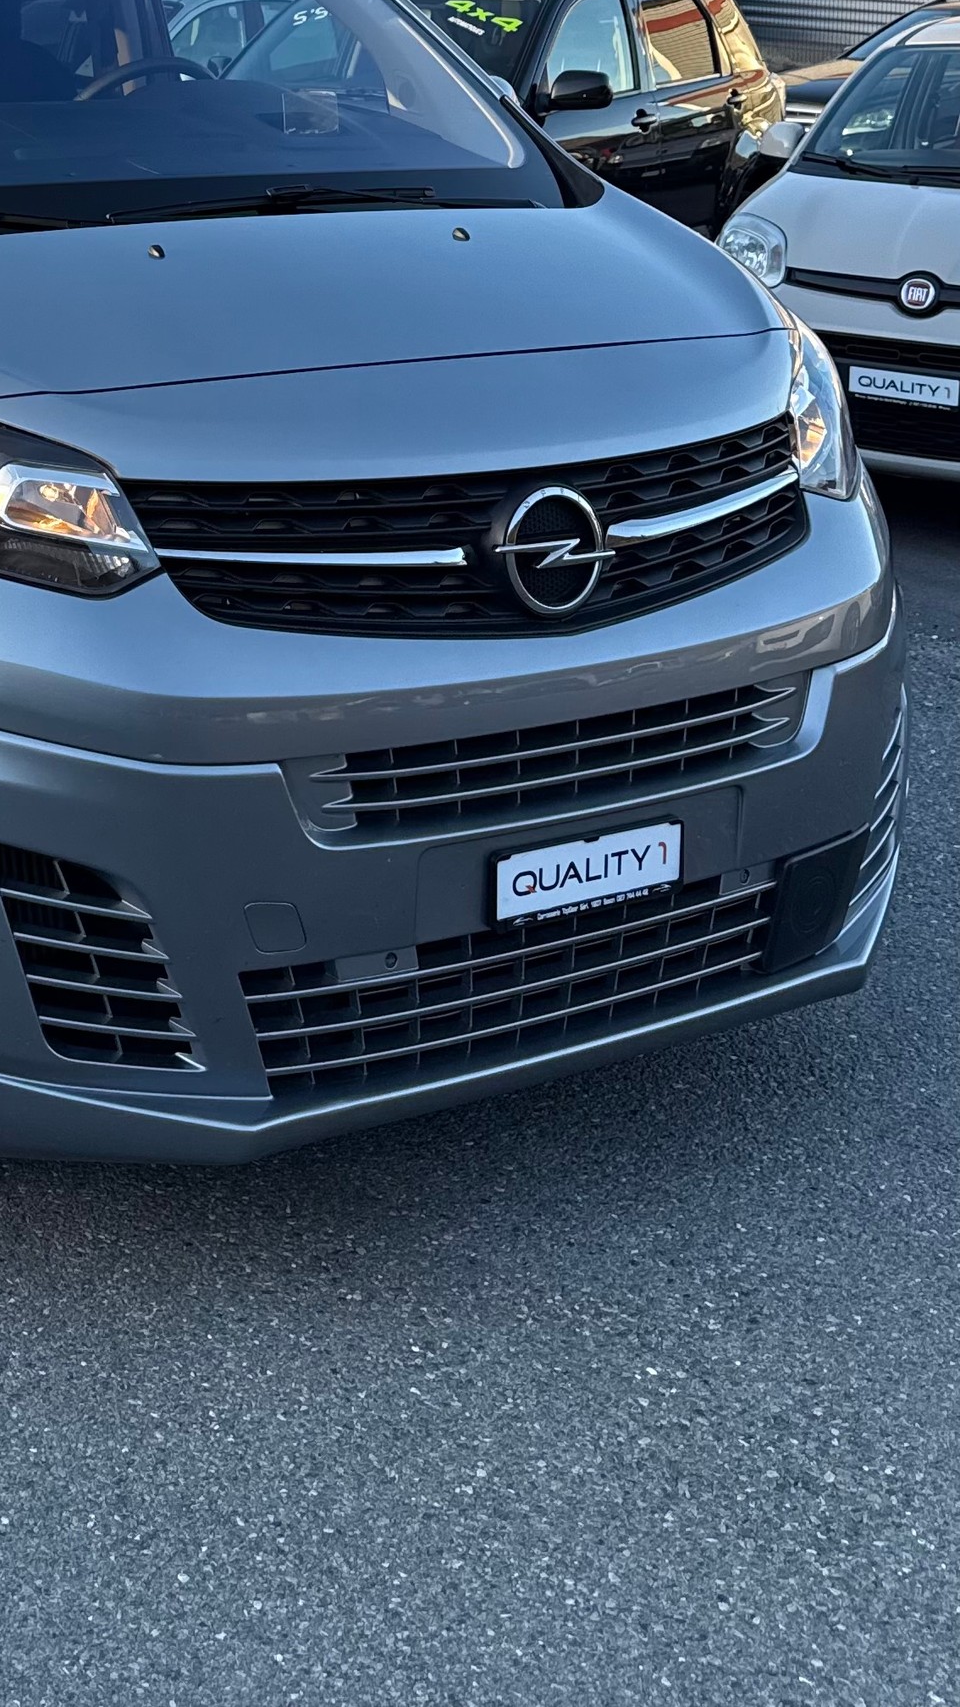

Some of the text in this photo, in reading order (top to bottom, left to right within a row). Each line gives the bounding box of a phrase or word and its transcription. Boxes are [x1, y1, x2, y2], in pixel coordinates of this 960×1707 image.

[445, 0, 524, 32] 4x4
[907, 286, 929, 302] FIAT
[858, 375, 951, 399] QUALITY 1
[522, 488, 582, 509] OPEL
[512, 841, 668, 897] QUALITY 1
